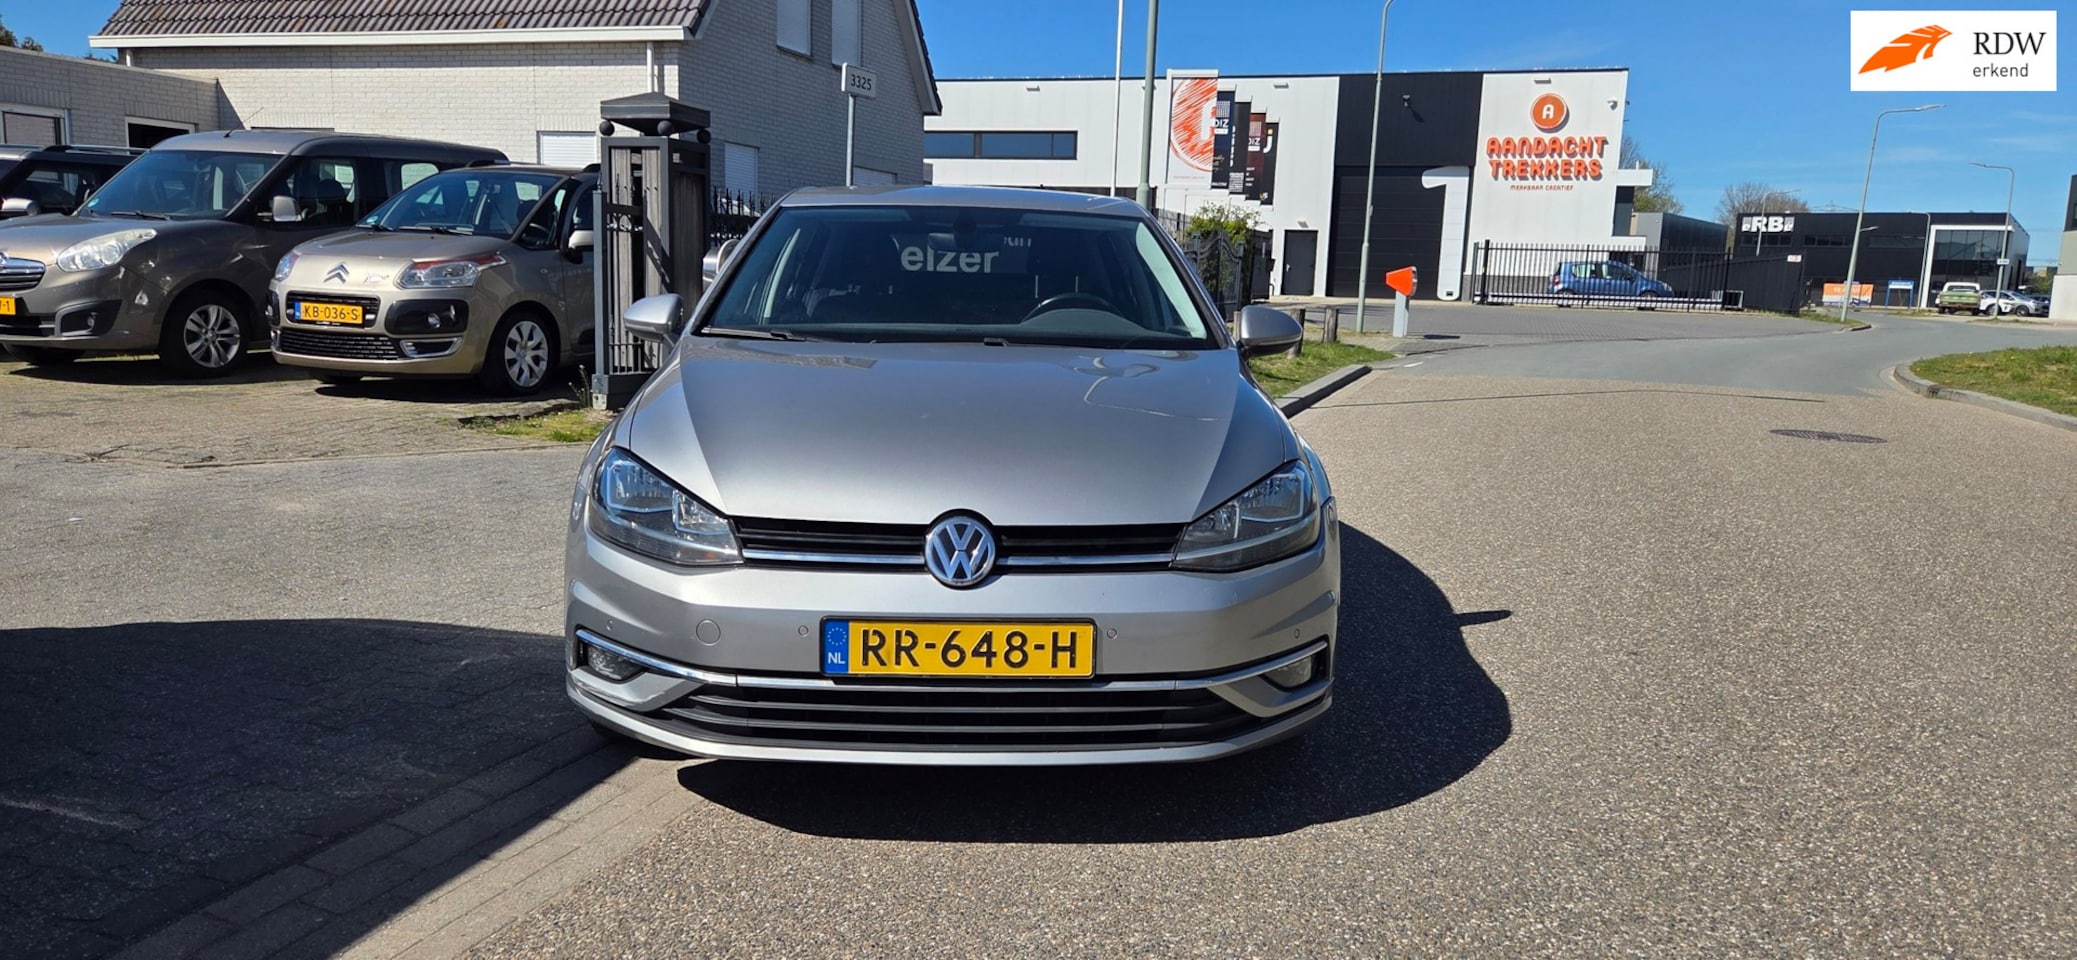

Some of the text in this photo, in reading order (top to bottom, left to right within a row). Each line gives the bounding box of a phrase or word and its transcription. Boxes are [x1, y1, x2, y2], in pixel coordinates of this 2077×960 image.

[850, 73, 872, 91] 3325
[1541, 104, 1555, 120] A
[1486, 136, 1609, 158] AANDACHT
[1489, 159, 1603, 181] TREKKERS
[1545, 184, 1574, 192] CREATIEF
[304, 305, 359, 320] KB-036-S
[827, 629, 1077, 669] NL RR-648-H
